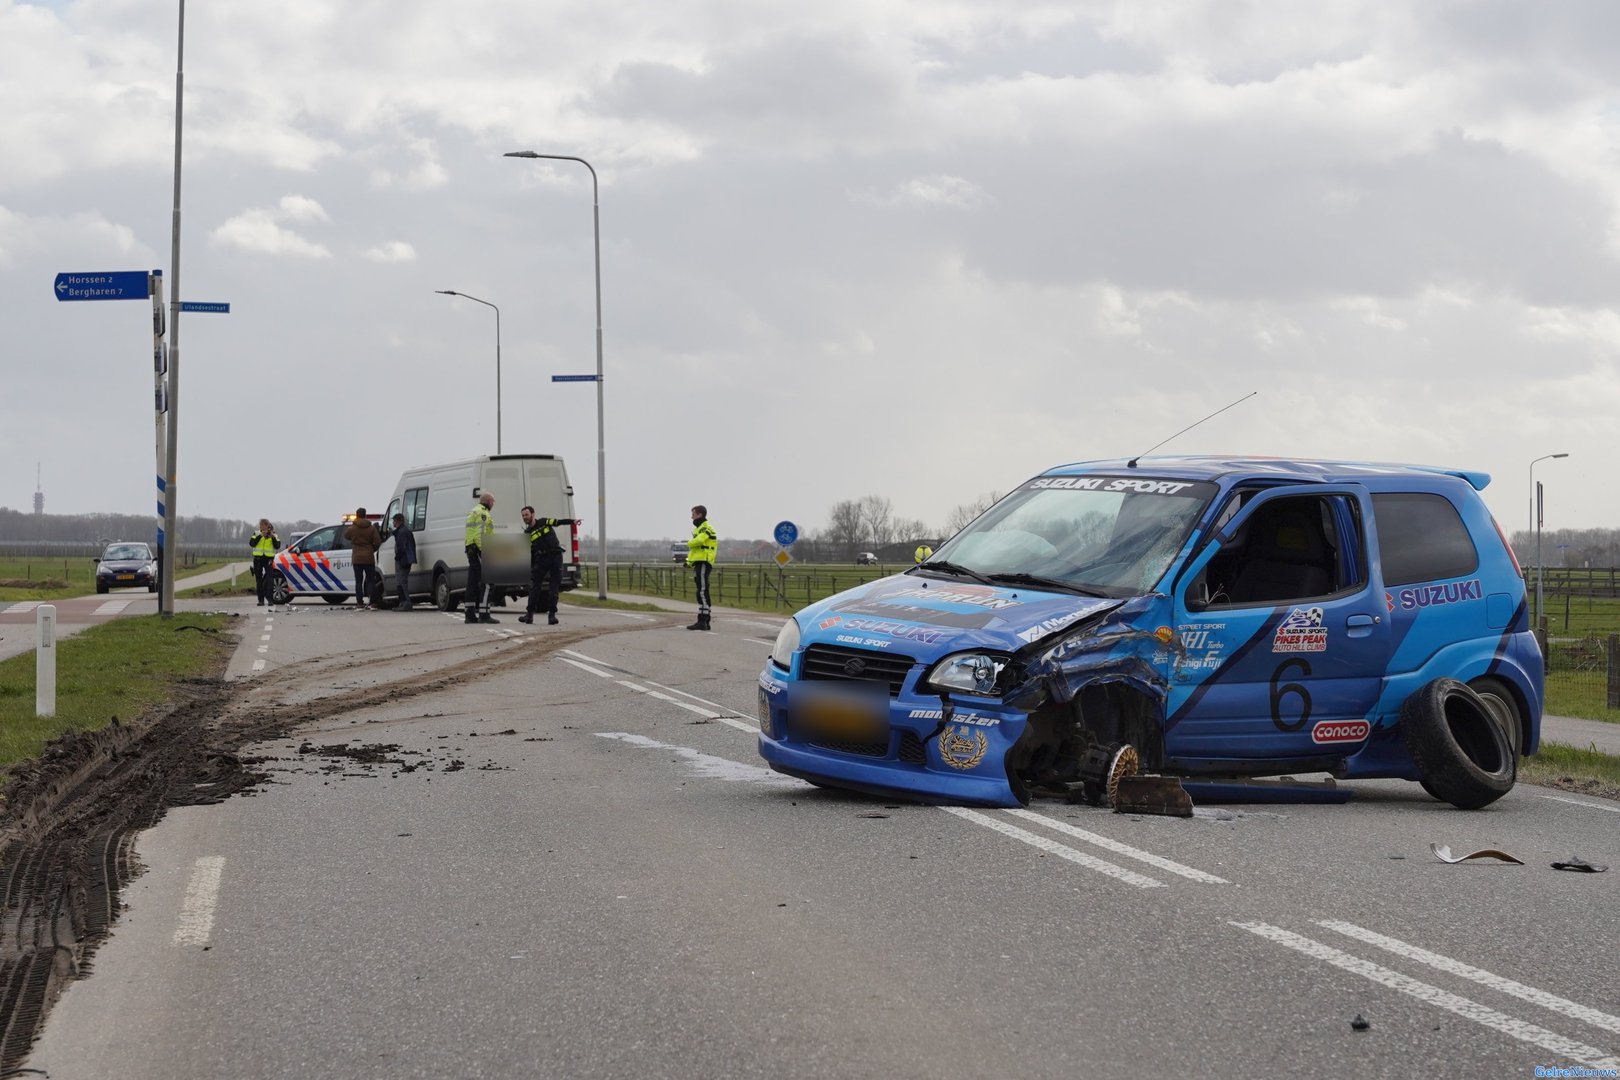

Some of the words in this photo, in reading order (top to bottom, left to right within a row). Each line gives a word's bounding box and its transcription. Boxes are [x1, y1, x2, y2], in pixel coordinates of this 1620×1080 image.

[69, 276, 106, 284] Horssen
[69, 287, 116, 297] Bergharen
[1030, 478, 1104, 490] SUZUKI
[1104, 479, 1194, 495] SPORT
[1400, 579, 1482, 611] SUZUKI
[842, 617, 947, 645] SUZUKI
[836, 635, 863, 645] SUZUKI
[863, 638, 892, 648] SPORT
[1207, 640, 1225, 649] Turbo
[1275, 635, 1301, 644] PIKES
[1302, 634, 1326, 644] PEAK
[1274, 644, 1291, 652] AUTO
[1306, 643, 1325, 651] CLIMB
[1269, 657, 1313, 732] 6
